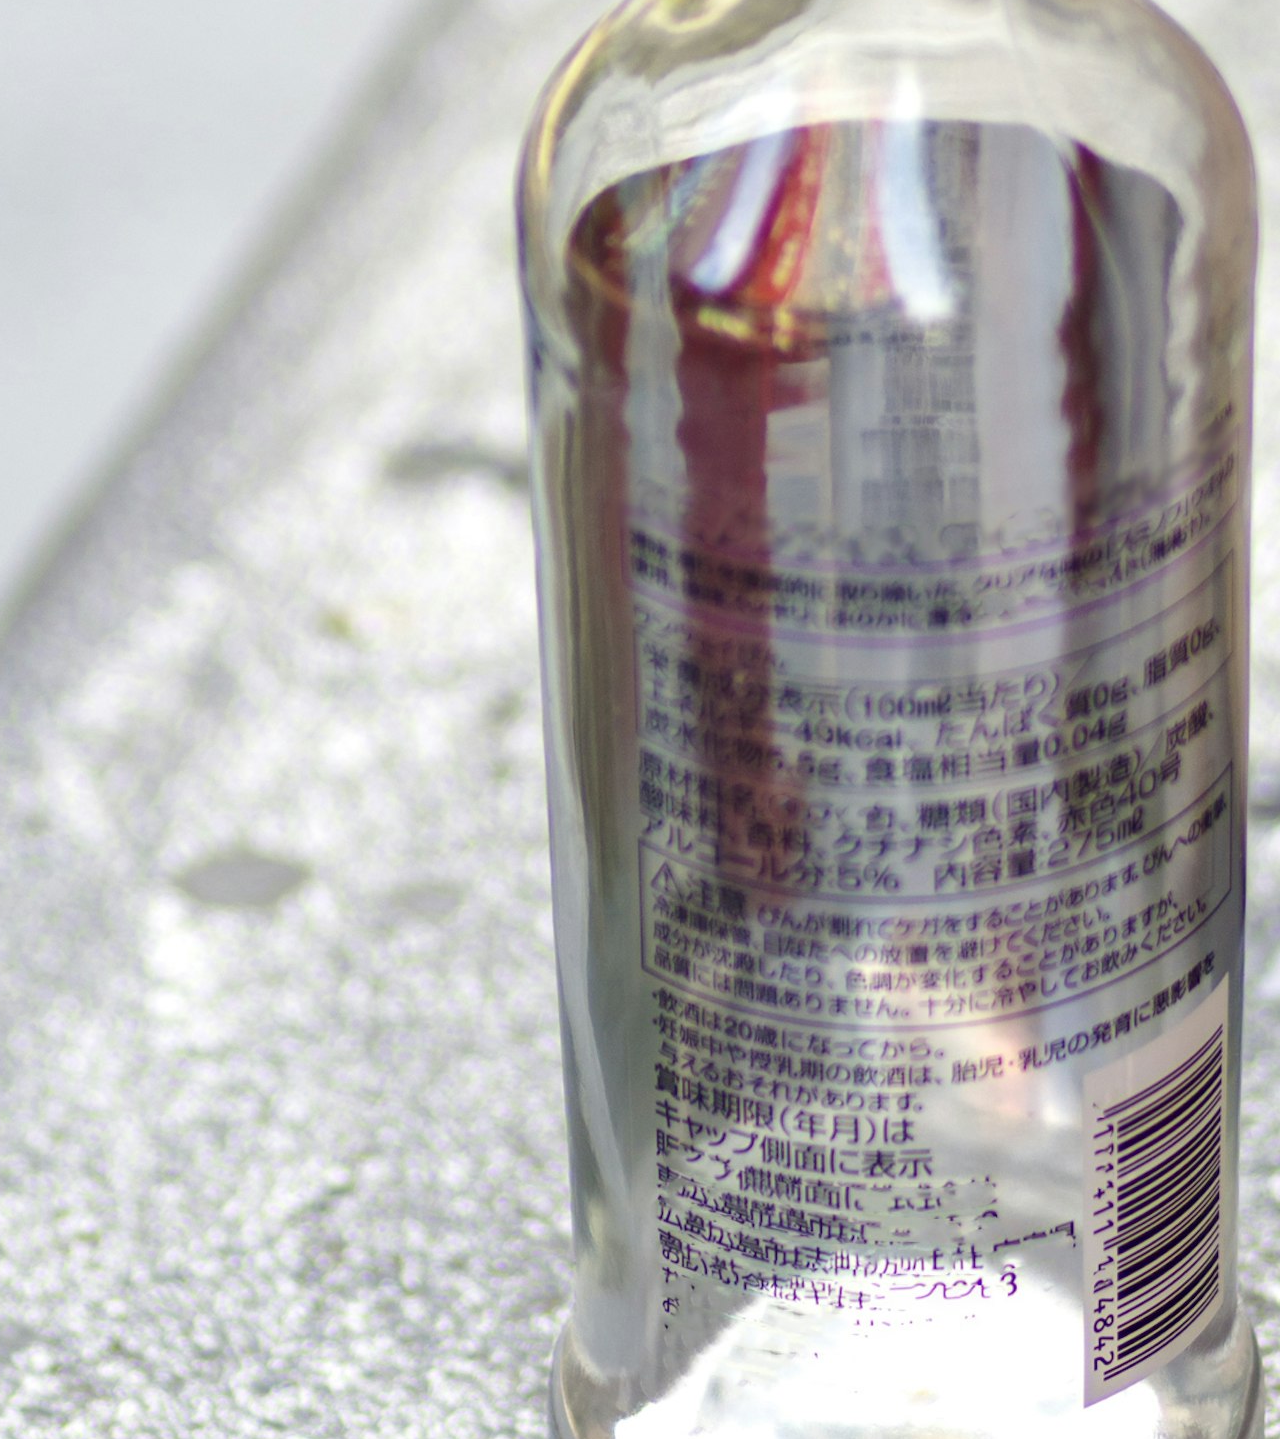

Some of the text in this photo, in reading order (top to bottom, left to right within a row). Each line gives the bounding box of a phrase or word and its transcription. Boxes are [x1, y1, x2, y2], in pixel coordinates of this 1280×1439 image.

[655, 1061, 915, 1145] 賞味期限(年月)は
[658, 1041, 924, 1113] 与えるおそれがあります。
[656, 1099, 934, 1179] キャップ側面に表示
